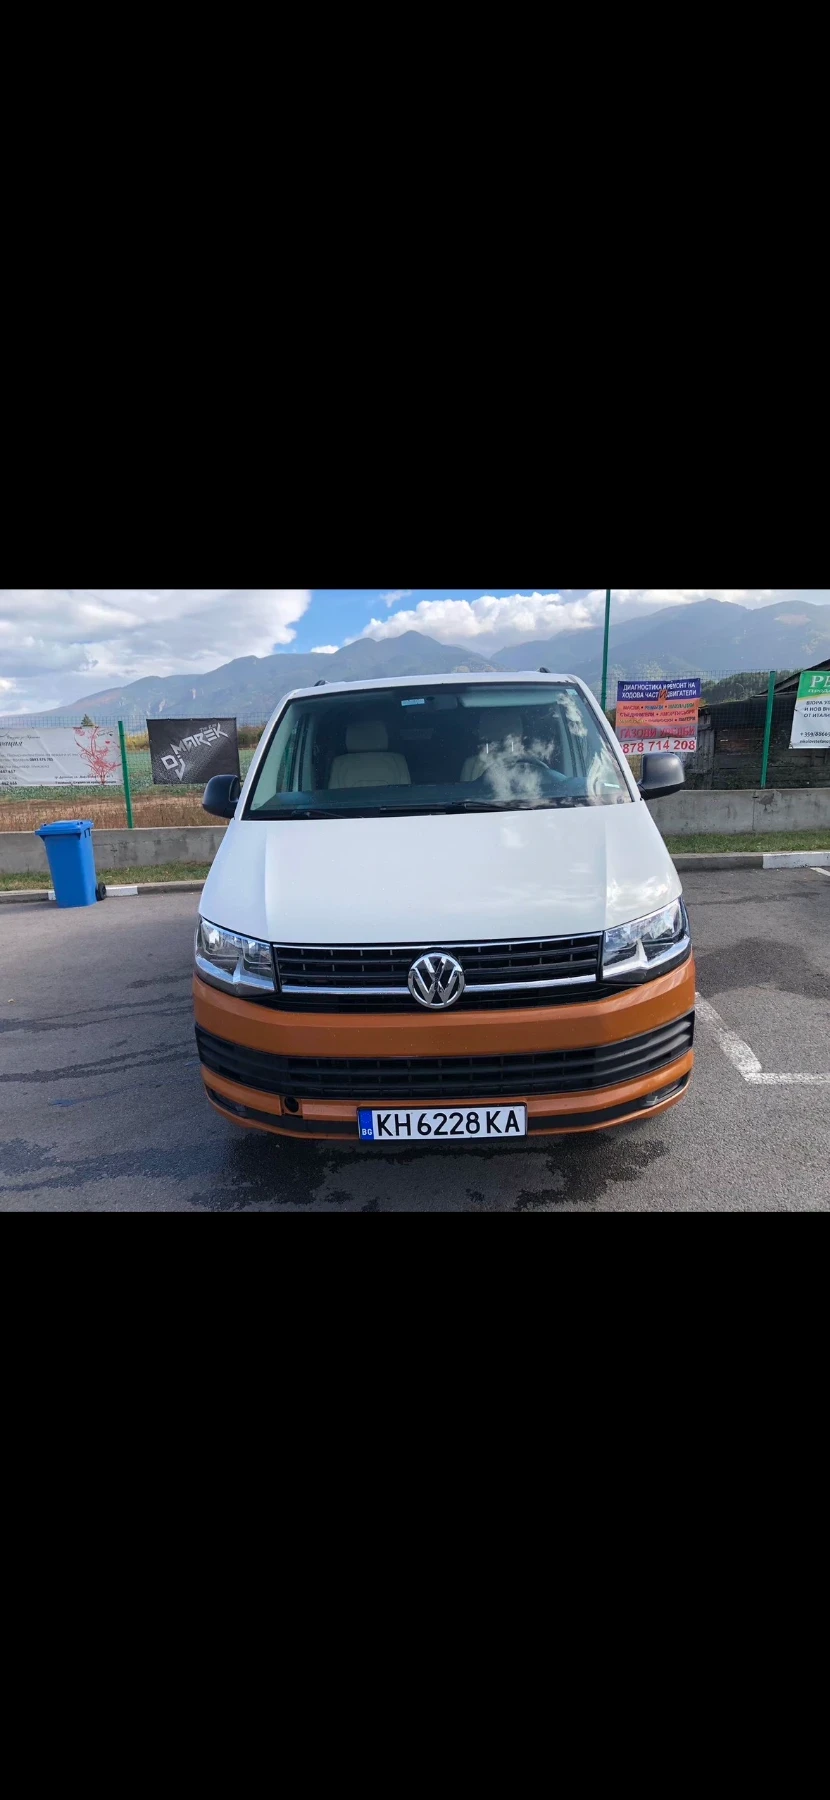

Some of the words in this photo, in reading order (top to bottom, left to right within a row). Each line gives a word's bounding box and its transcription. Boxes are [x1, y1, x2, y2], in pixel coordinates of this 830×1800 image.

[666, 690, 696, 698] ДВИГАТЕЛИ
[170, 722, 229, 754] MAREK
[620, 742, 644, 754] 878
[649, 740, 669, 751] 714
[674, 740, 695, 750] 208
[377, 1114, 411, 1136] KH
[417, 1112, 480, 1136] 6228
[486, 1110, 520, 1134] KA
